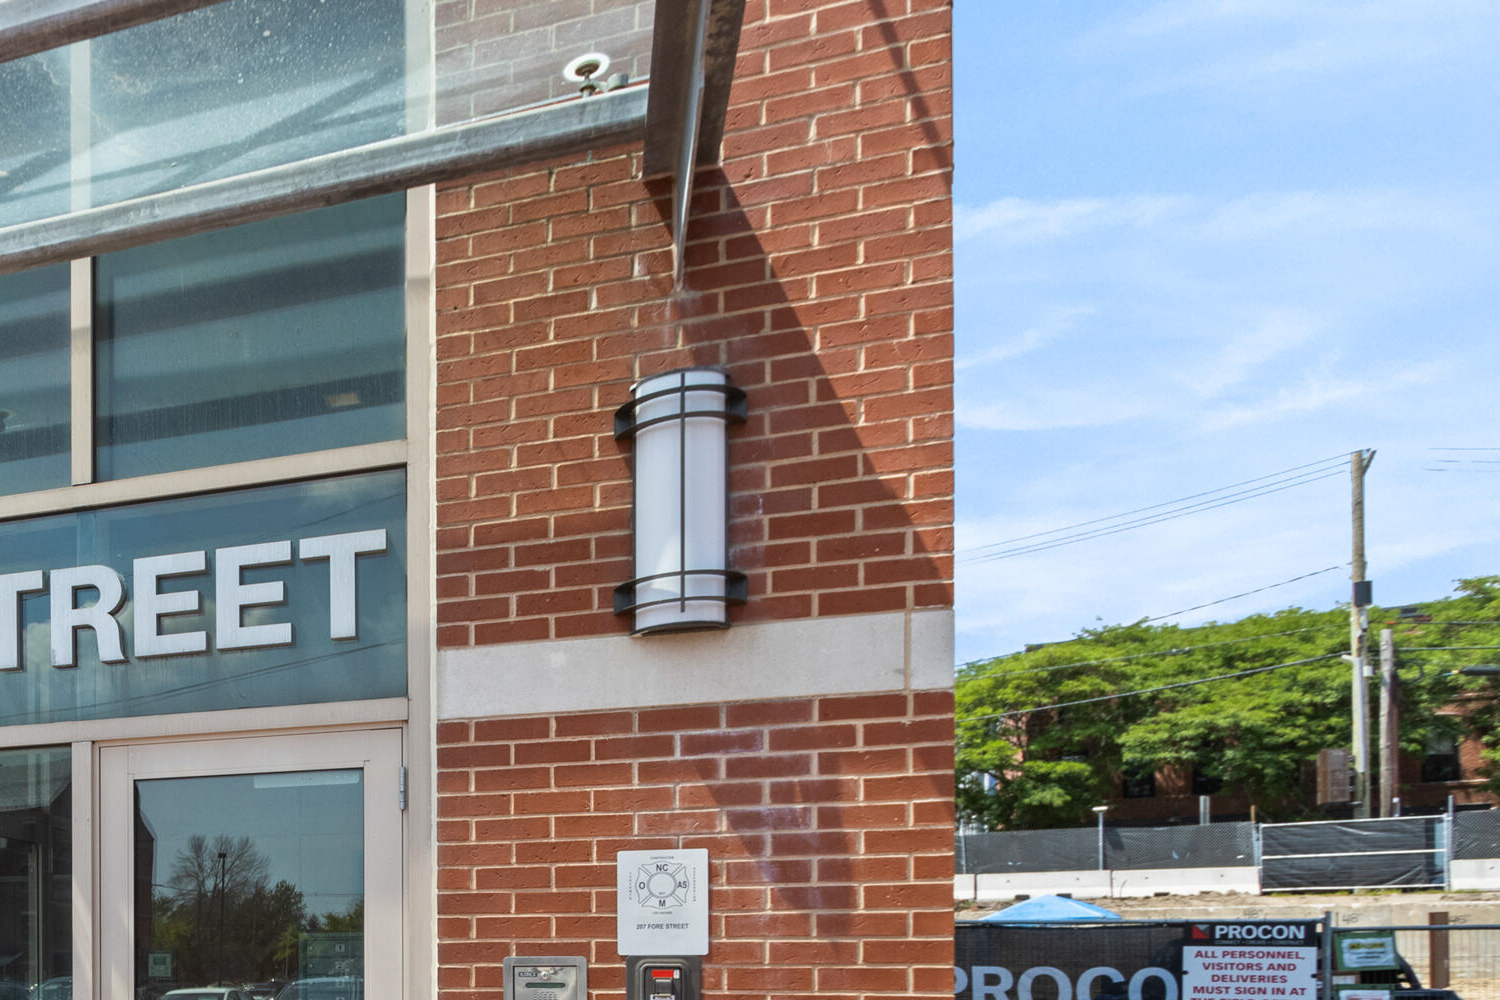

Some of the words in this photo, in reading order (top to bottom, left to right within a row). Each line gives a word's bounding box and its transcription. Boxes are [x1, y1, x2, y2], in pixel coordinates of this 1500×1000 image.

[656, 864, 669, 872] NC
[677, 881, 687, 889] AS
[1214, 925, 1306, 939] PROCON
[1194, 950, 1218, 959] ALL
[1222, 950, 1306, 960] PERSONNEL,
[1202, 962, 1263, 971] VISITORS
[1267, 963, 1297, 971] AND
[1211, 974, 1288, 984] DELIVERIES
[1193, 986, 1231, 995] MUST
[1235, 987, 1267, 995] SIGN
[1271, 987, 1286, 995] IN
[1289, 987, 1307, 996] AT
